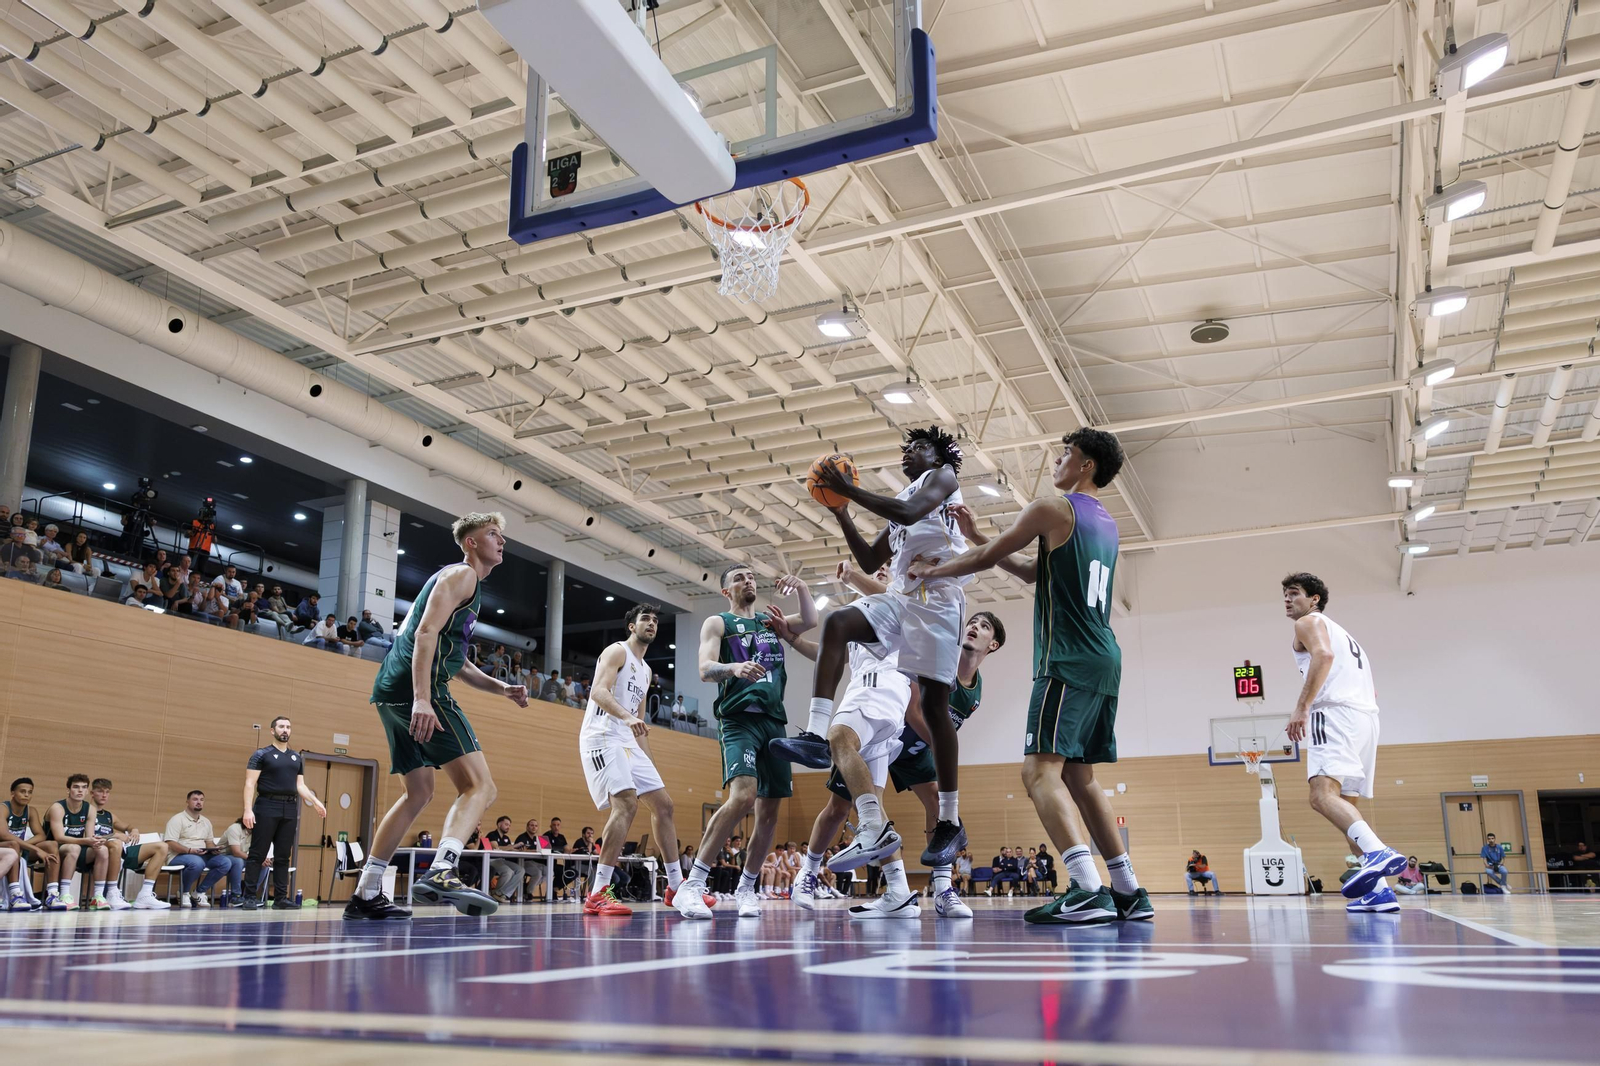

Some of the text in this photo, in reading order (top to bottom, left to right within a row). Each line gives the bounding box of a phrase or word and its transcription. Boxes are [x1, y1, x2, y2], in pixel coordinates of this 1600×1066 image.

[550, 155, 578, 172] LIGA
[552, 172, 576, 188] 2 2
[1346, 634, 1363, 669] 4
[1239, 678, 1259, 695] 06
[1261, 858, 1285, 866] LIGA
